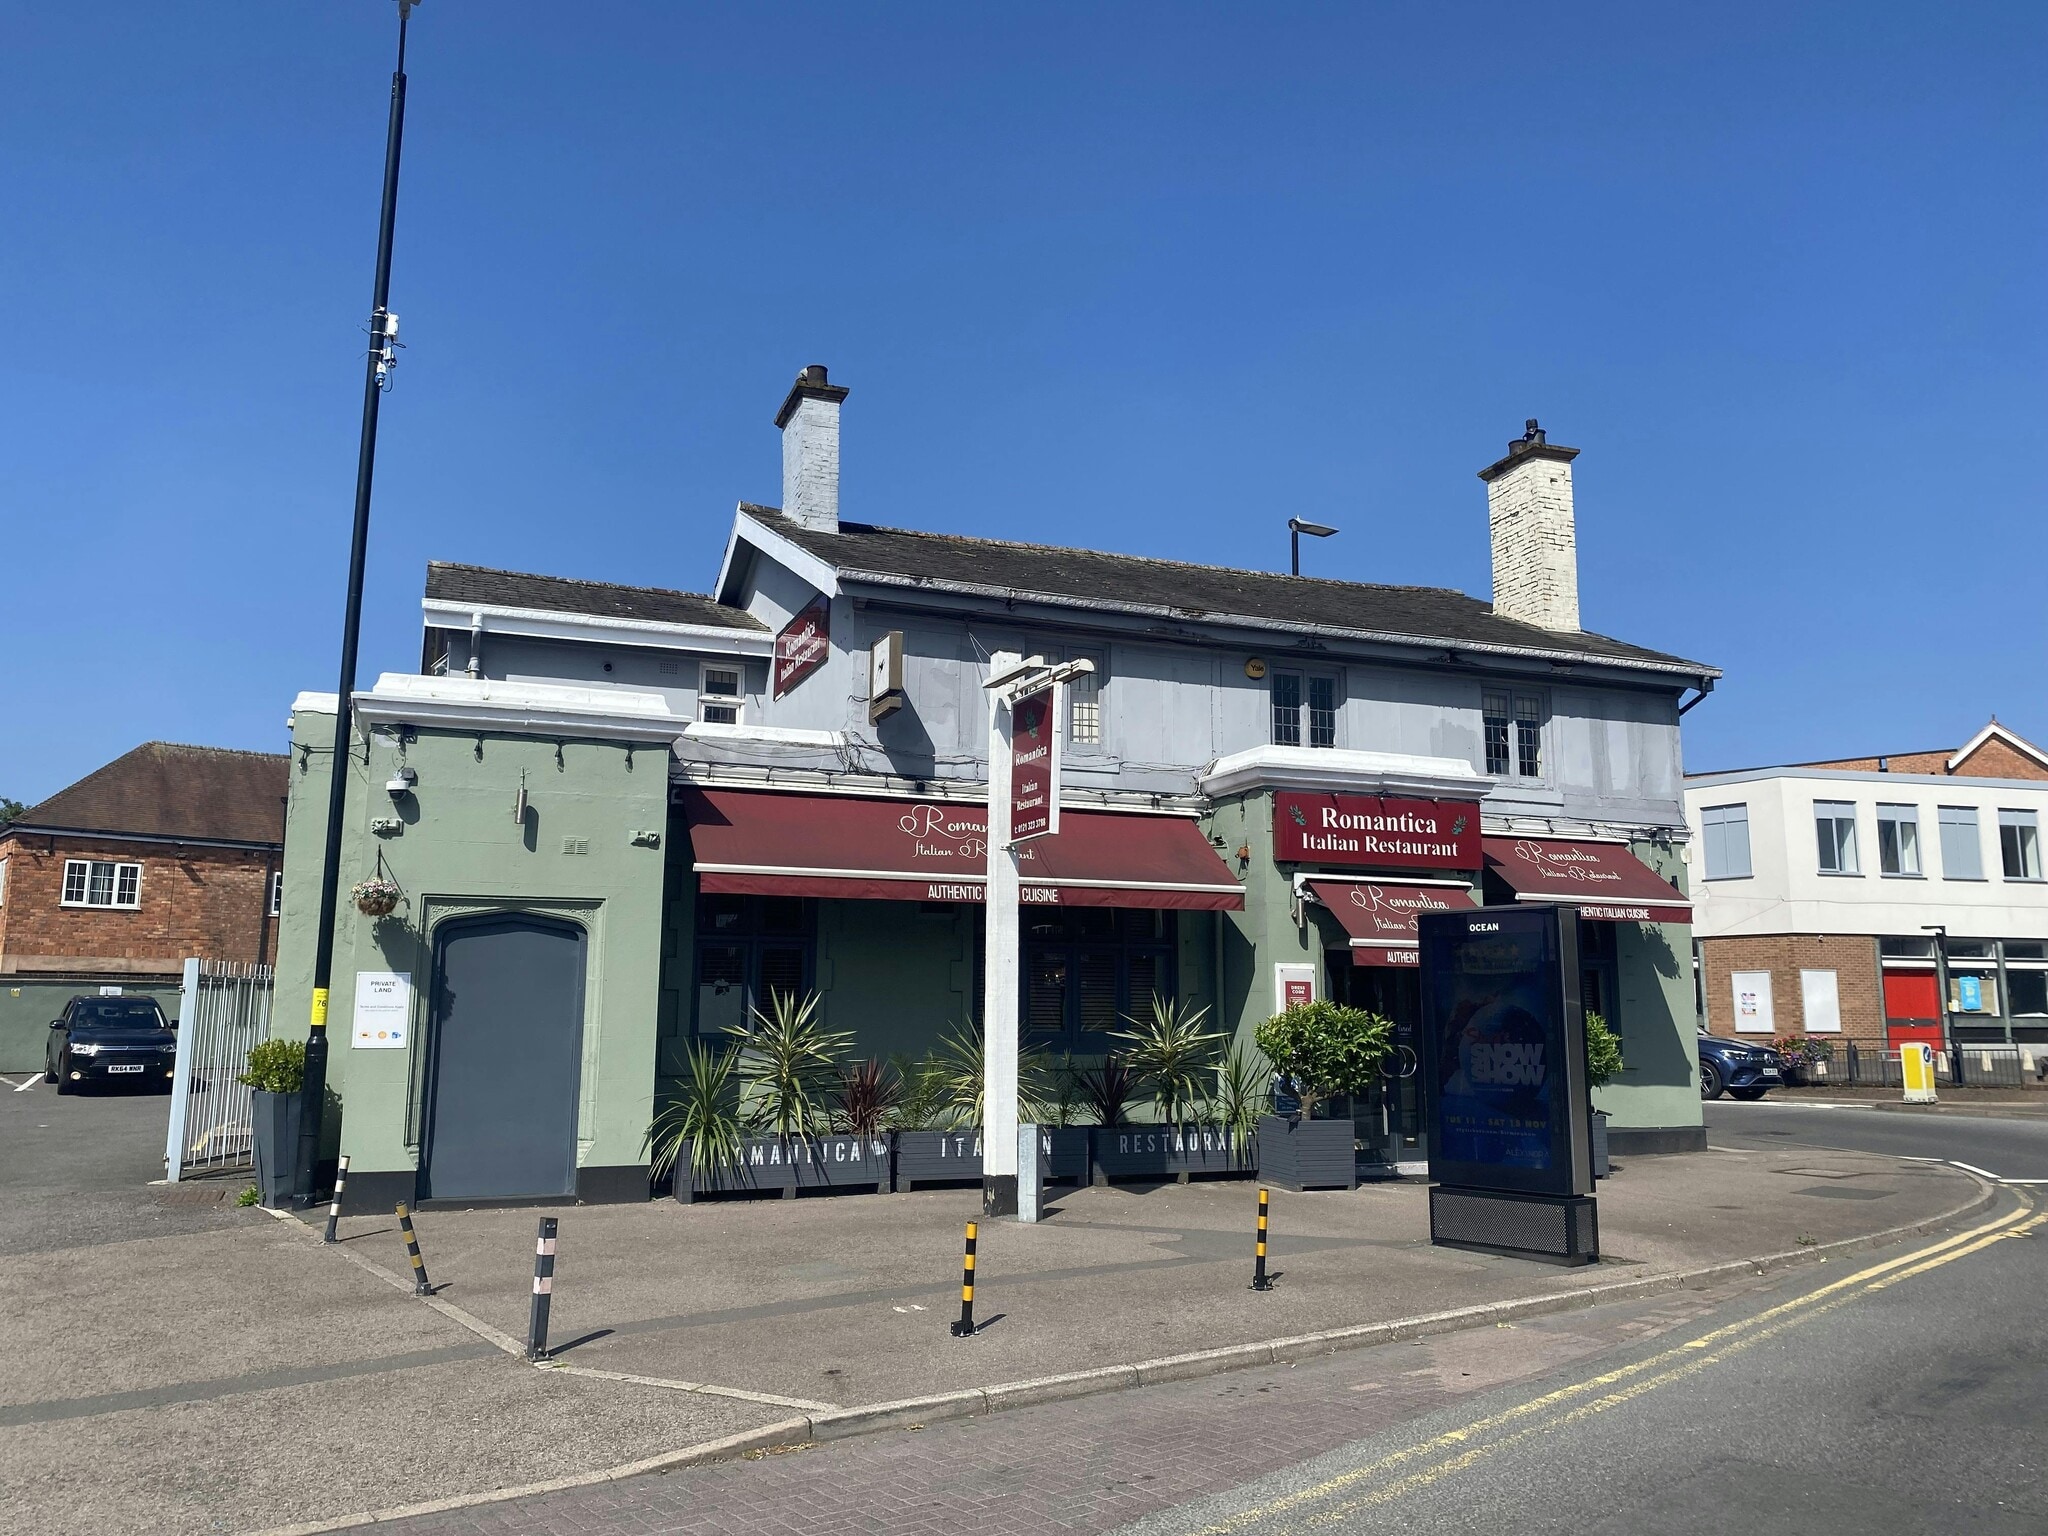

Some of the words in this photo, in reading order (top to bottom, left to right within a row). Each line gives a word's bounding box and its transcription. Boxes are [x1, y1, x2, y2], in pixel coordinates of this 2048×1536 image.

[785, 621, 815, 659] Romantica
[780, 662, 794, 683] Italian
[795, 636, 821, 671] Restaurant
[1250, 664, 1265, 672] Yale
[1015, 744, 1047, 766] Romantica
[1021, 779, 1038, 794] Italian
[1016, 794, 1043, 812] Restaurant
[1018, 822, 1027, 832] 0121
[1321, 807, 1437, 834] Romantica
[912, 839, 954, 858] Italian
[1302, 832, 1359, 852] Italian
[1365, 836, 1459, 857] Restaurant
[1515, 839, 1601, 867] Romantica
[928, 884, 982, 901] AUTHENTIC
[1021, 887, 1059, 903] CUISINE
[1350, 884, 1450, 915] Romantica
[1372, 913, 1406, 932] Italian
[1602, 907, 1627, 919] ITALIAN
[1625, 908, 1651, 920] CUISINE
[1469, 922, 1500, 932] OCEAN
[1387, 951, 1420, 964] AUTHENT
[1470, 1043, 1544, 1065] SNOW
[1470, 1063, 1546, 1086] SHOW
[1488, 1118, 1505, 1127] SAT
[1525, 1120, 1548, 1129] NOV
[941, 1135, 1052, 1158] ITAN
